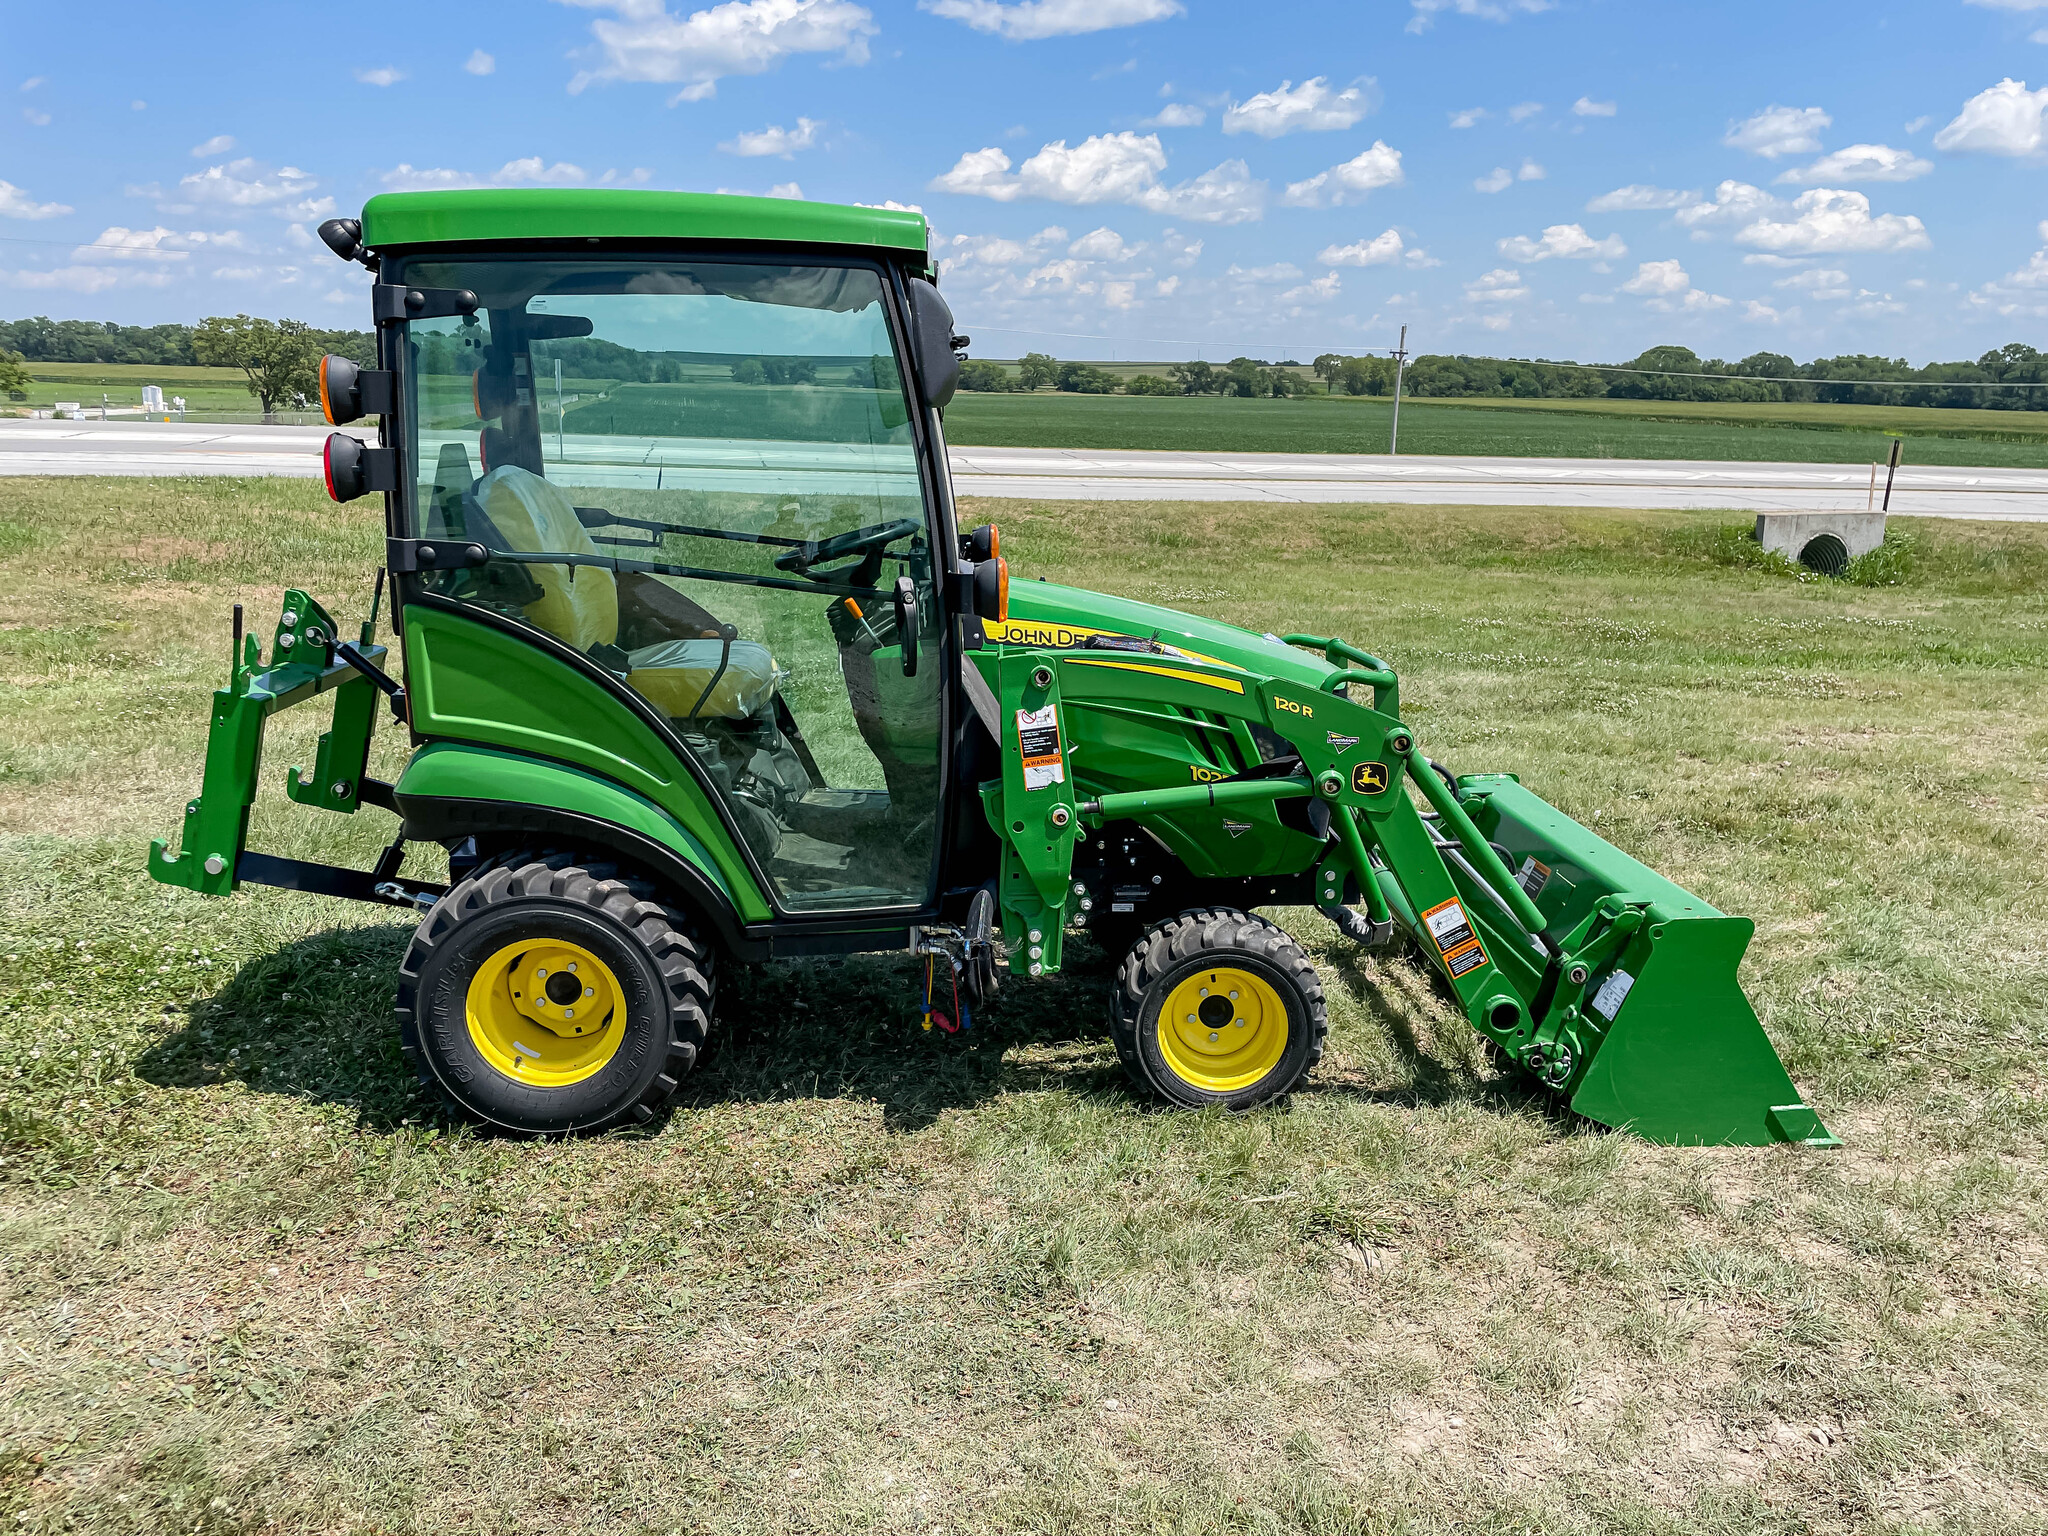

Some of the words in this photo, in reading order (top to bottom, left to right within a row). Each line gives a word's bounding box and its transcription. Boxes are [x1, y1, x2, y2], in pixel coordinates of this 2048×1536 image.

[998, 625, 1052, 644] JOHN
[1030, 757, 1060, 766] WARNING
[1431, 900, 1454, 913] WARNING
[1453, 943, 1476, 955] WARNING
